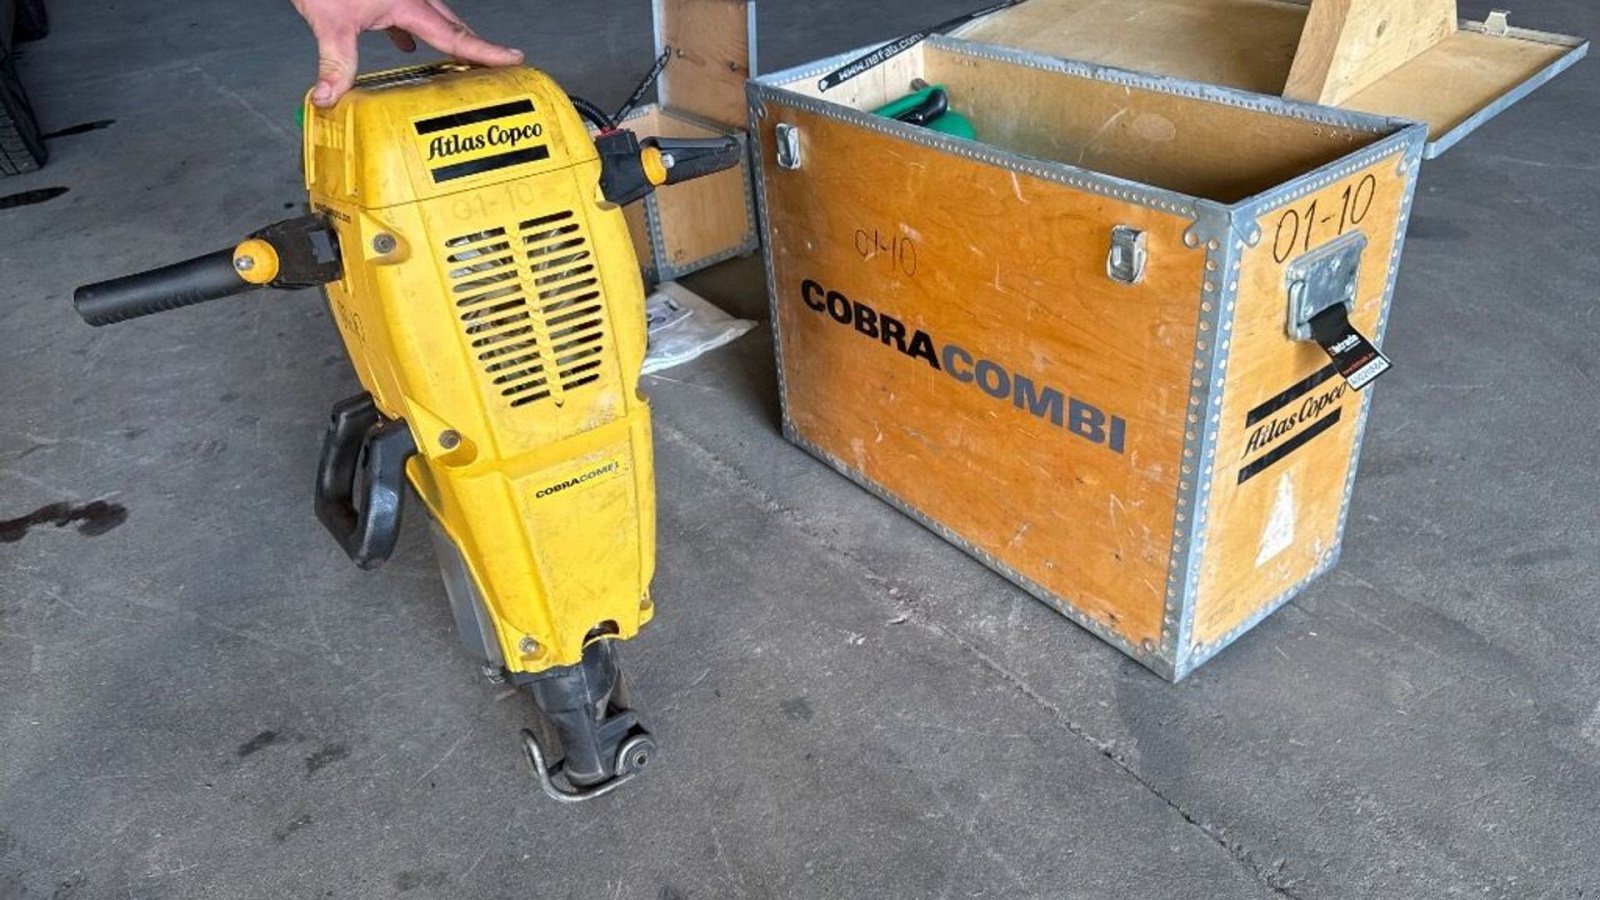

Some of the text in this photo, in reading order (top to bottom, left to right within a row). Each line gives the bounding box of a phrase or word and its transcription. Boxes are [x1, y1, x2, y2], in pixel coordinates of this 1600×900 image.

[427, 122, 543, 160] Atlas Copco
[1273, 173, 1377, 264] 01-10
[854, 228, 918, 278] 01-10
[1240, 382, 1347, 460] Atlas Copco
